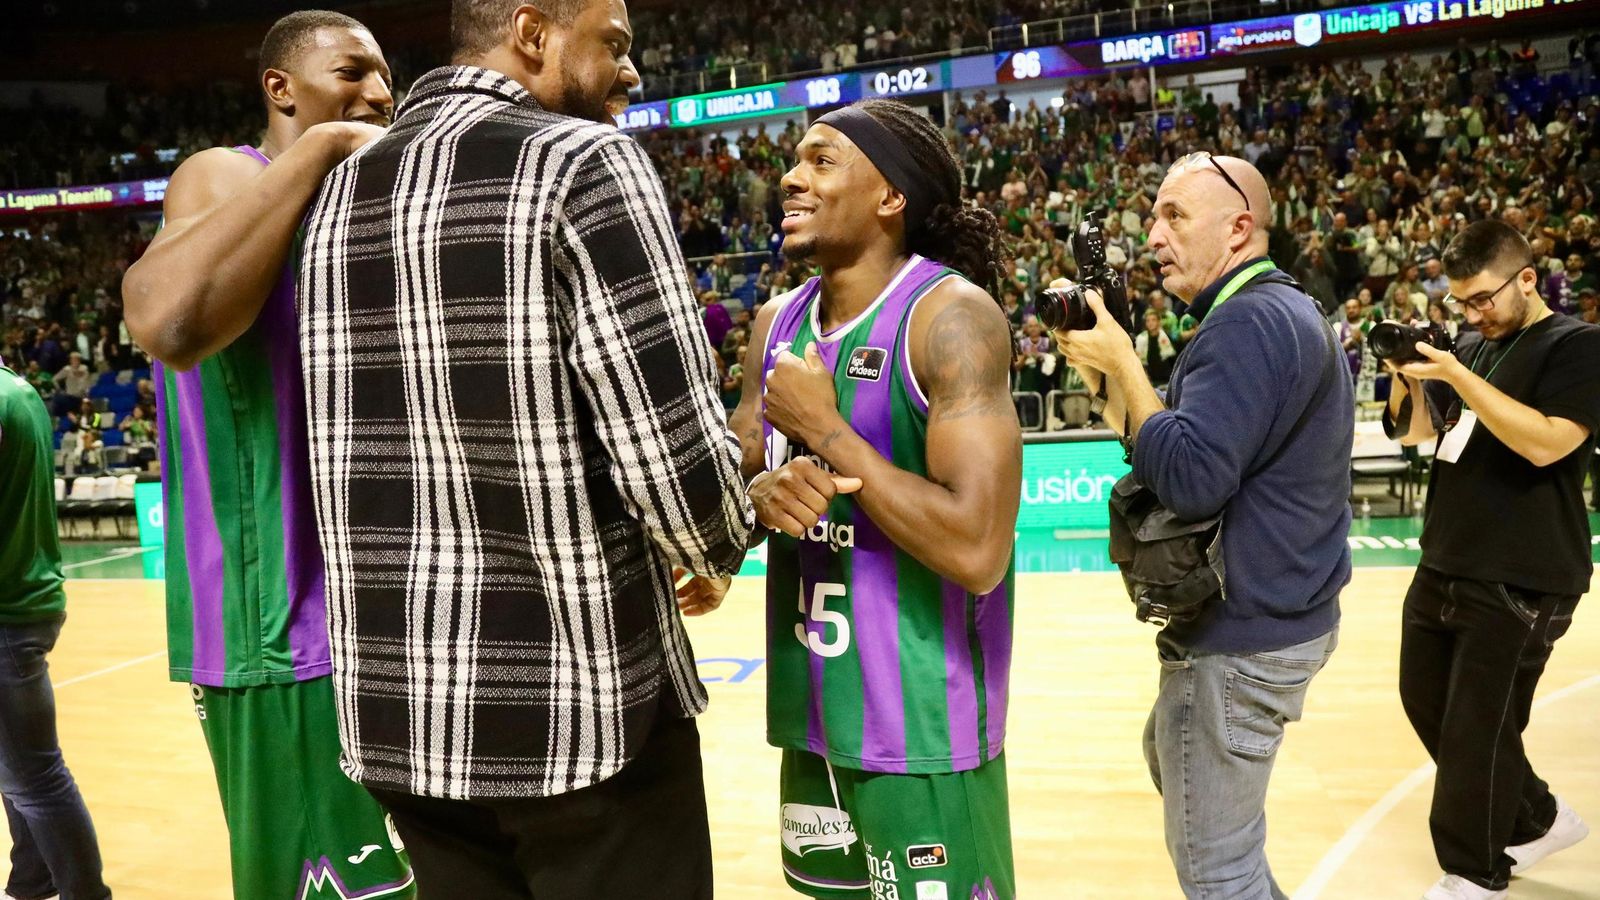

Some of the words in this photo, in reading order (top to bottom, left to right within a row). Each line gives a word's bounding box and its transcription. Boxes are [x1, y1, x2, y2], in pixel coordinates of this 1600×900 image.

[1326, 7, 1400, 35] Unicaja
[1404, 1, 1433, 25] VS
[1438, 0, 1463, 20] La
[1101, 35, 1165, 63] BARÇA
[1012, 51, 1041, 79] 96
[806, 78, 840, 106] 103
[874, 67, 928, 95] 0:02
[706, 90, 775, 117] UNICAJA
[8, 193, 57, 210] Laguna
[59, 186, 113, 205] Tenerife
[1022, 468, 1117, 504] usión
[912, 853, 938, 866] acb
